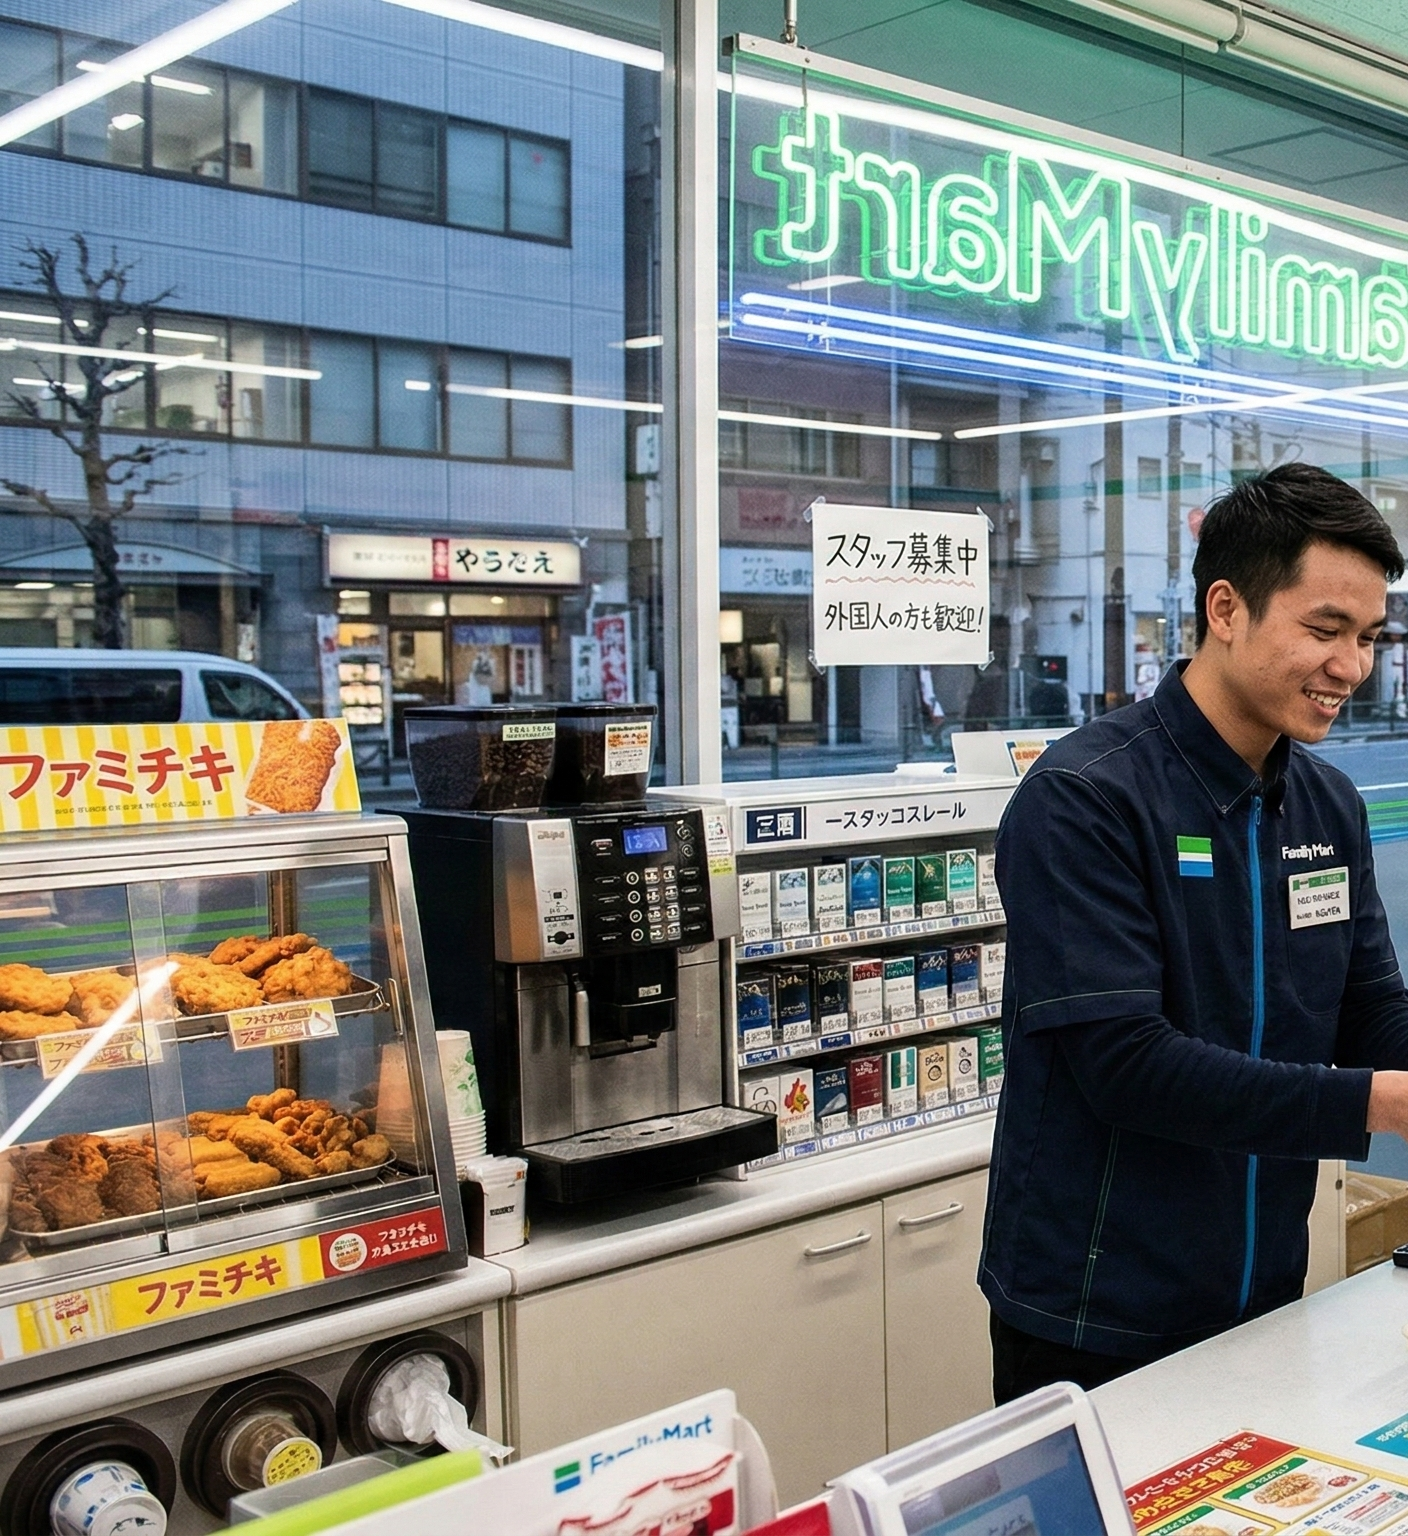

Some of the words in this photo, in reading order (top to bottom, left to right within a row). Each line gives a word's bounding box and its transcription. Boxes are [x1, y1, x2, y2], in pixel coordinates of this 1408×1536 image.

[826, 532, 978, 576] スタッフ募集中
[0, 745, 234, 799] ファミチキ
[138, 1255, 282, 1315] ファミチキ
